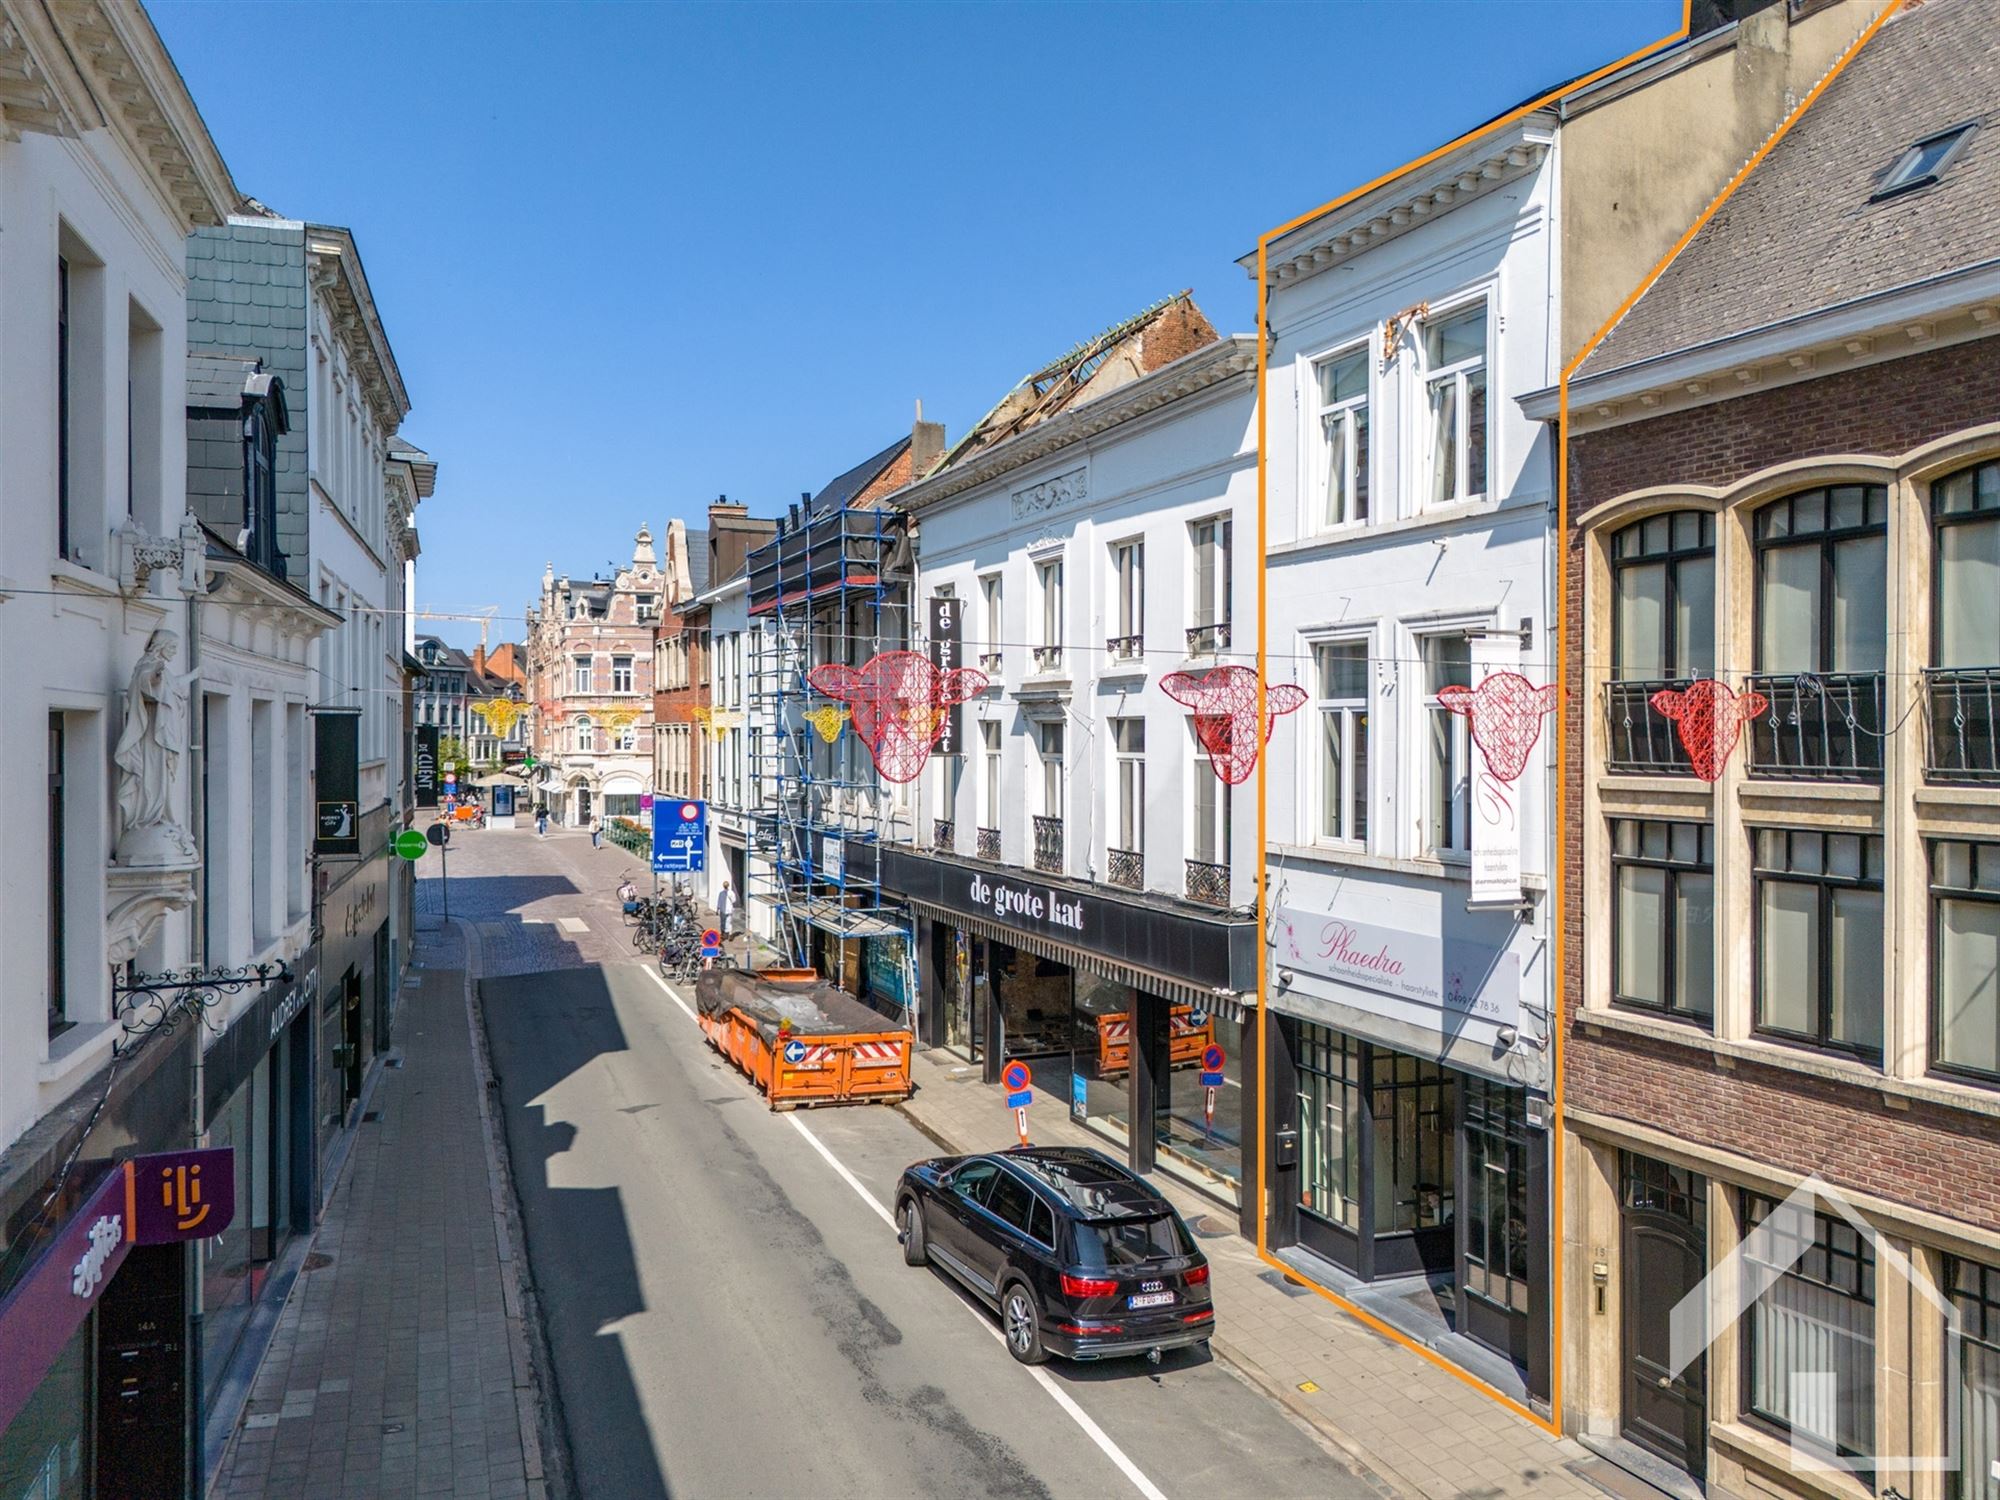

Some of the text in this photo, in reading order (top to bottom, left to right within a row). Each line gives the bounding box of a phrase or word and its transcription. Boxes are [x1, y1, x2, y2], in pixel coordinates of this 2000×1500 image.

[938, 602, 952, 629] de
[970, 873, 1084, 930] de grote kat
[1317, 921, 1405, 976] Phaedra
